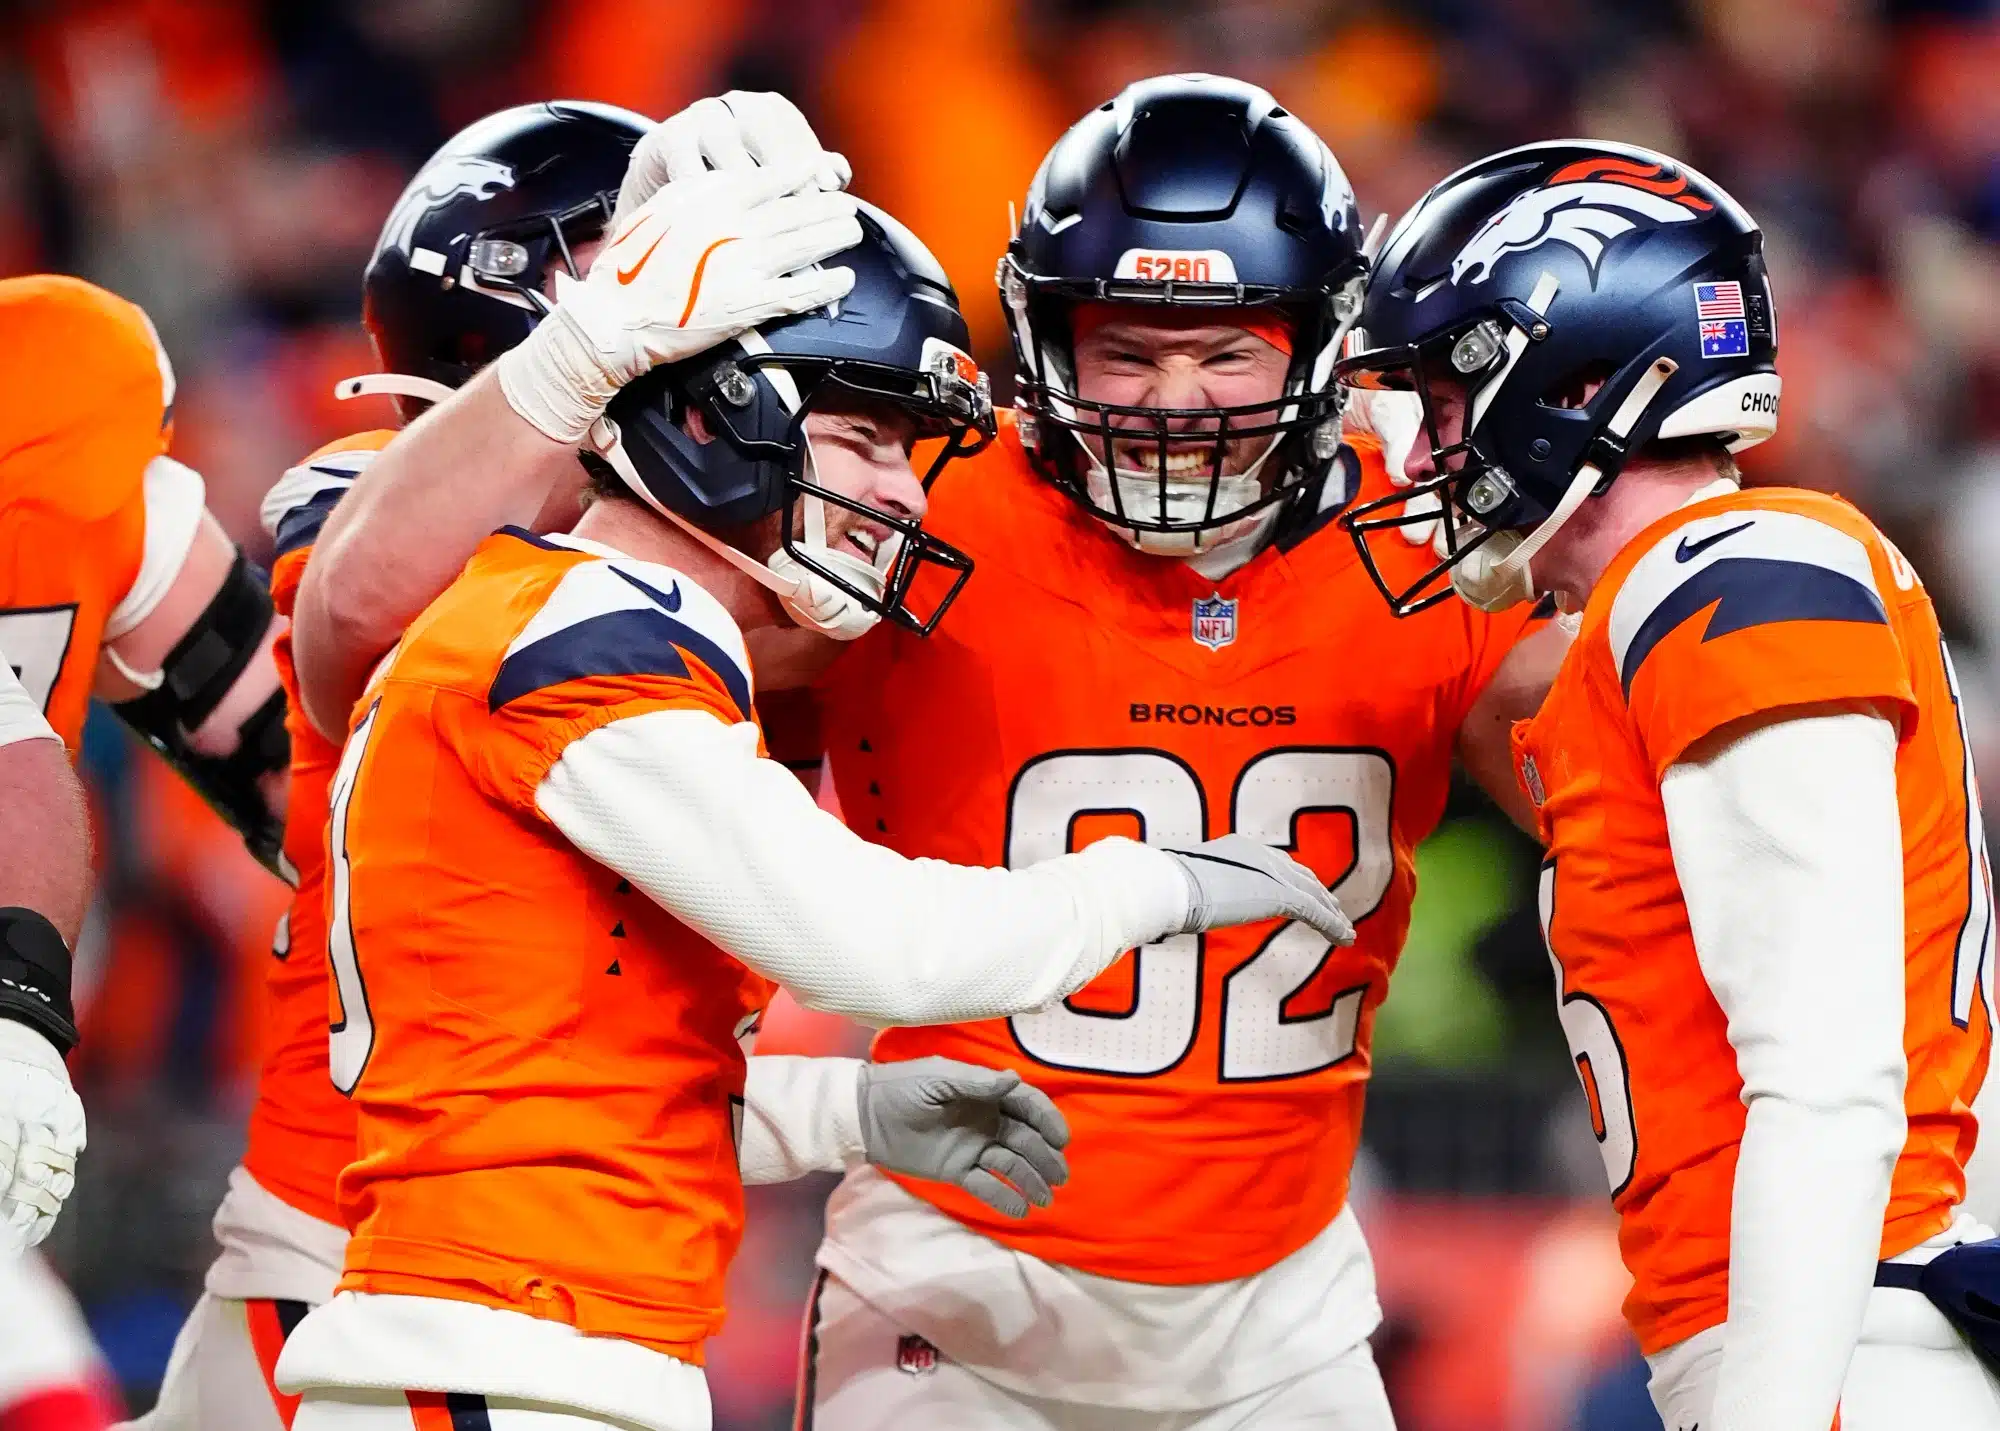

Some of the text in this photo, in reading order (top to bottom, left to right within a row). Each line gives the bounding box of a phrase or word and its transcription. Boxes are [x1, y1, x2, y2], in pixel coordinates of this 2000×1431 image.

[1135, 256, 1211, 283] 5280
[1741, 392, 1780, 417] CHOO
[1200, 620, 1231, 640] NFL
[1129, 703, 1297, 727] BRONCOS
